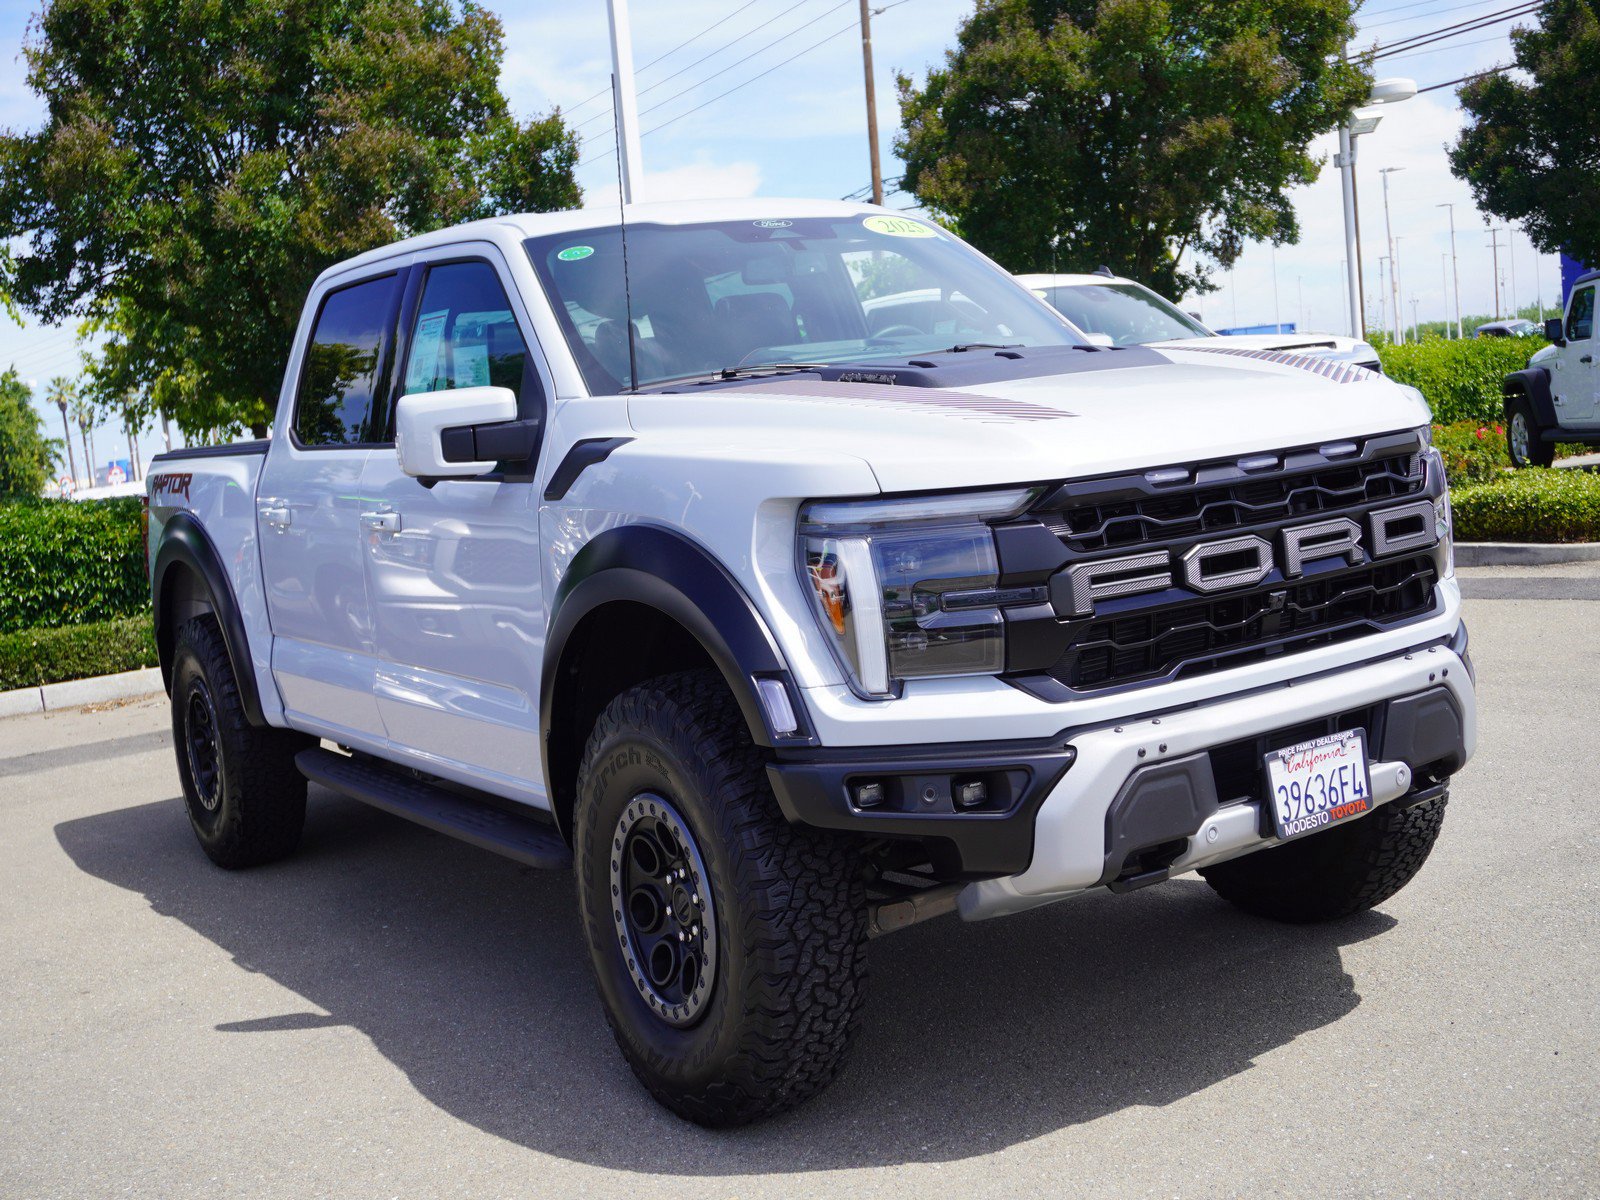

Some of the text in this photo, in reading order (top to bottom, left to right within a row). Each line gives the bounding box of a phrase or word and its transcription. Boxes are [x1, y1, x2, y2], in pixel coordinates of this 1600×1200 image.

[877, 219, 925, 234] 2025
[151, 473, 193, 503] RAPTOR
[1051, 500, 1438, 618] FORD
[1278, 730, 1354, 758] PRICE FAMILY DEALERSHIPS
[1287, 747, 1347, 773] California
[1278, 763, 1364, 822] 39636F4
[1284, 799, 1367, 836] MODESTO TOYOTA
